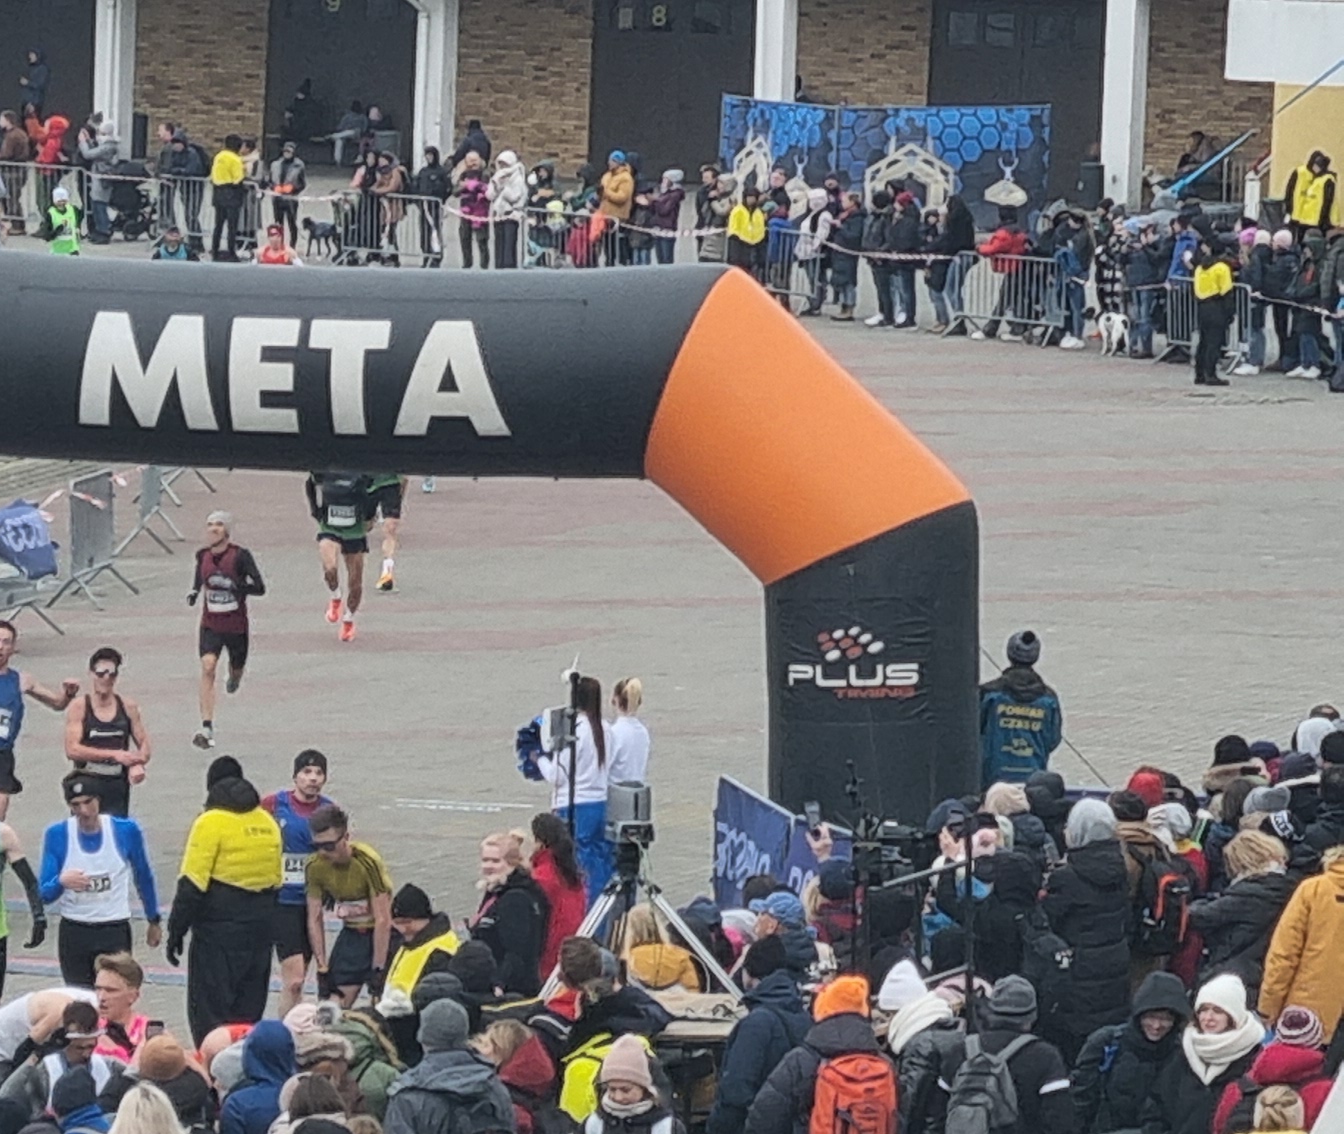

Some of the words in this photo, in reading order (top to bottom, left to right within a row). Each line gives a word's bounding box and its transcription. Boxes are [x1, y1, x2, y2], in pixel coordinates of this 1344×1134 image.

[652, 5, 667, 27] 8
[78, 311, 511, 436] META
[788, 663, 920, 687] PLUS
[833, 687, 916, 700] TIMING
